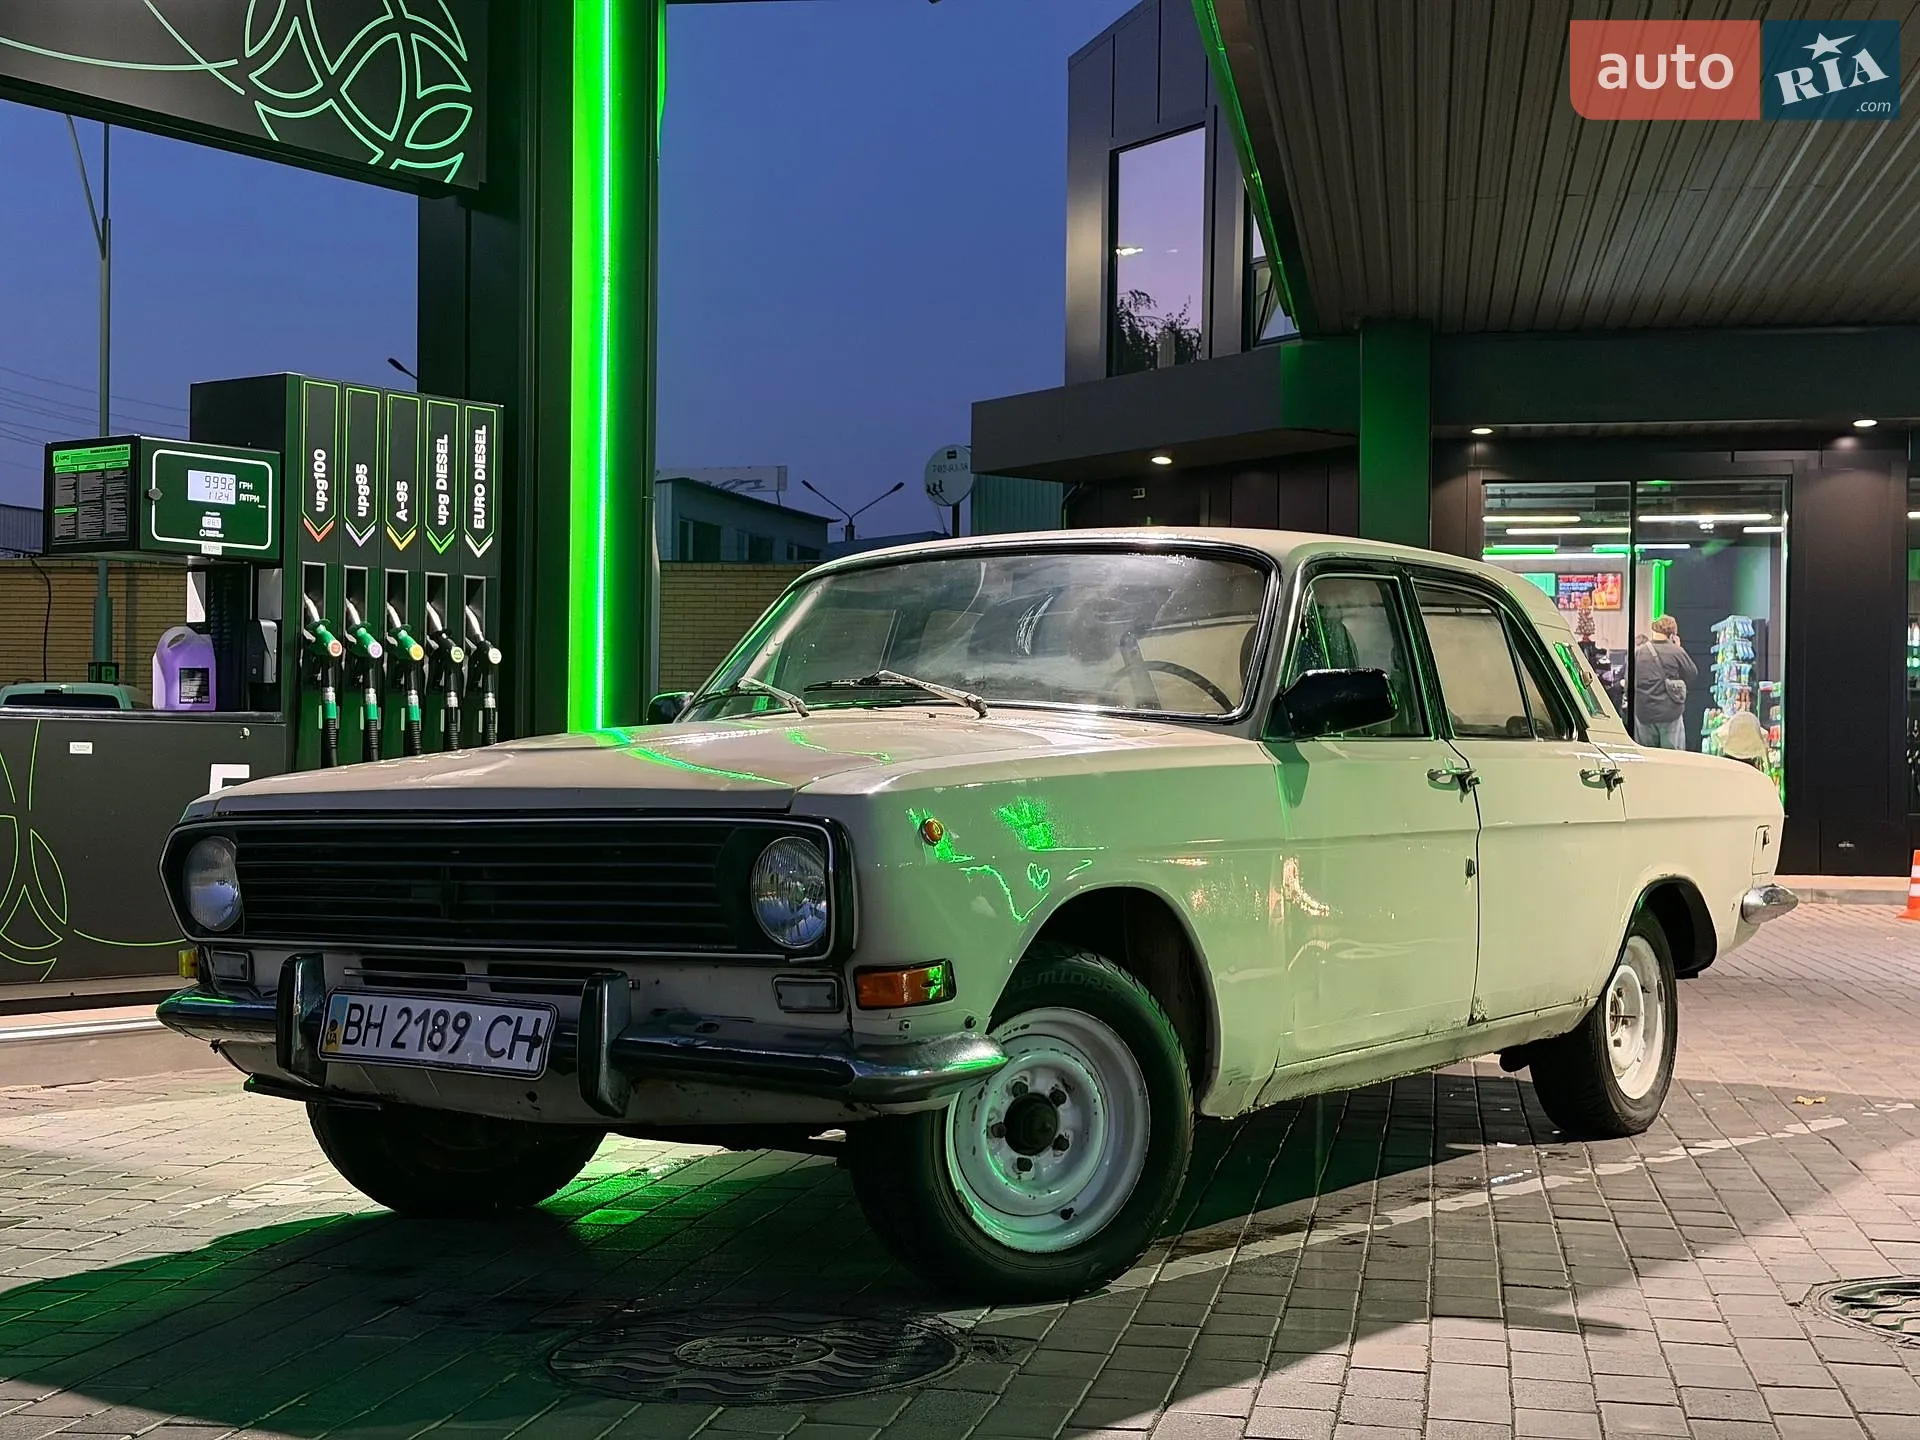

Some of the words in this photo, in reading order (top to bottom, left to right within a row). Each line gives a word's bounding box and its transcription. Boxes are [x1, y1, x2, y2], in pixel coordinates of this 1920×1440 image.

[436, 434, 448, 491] DIESEL
[474, 424, 487, 481] DIESEL
[239, 481, 253, 490] ГРН
[313, 449, 328, 512] upg100
[355, 463, 370, 517] upg95
[395, 480, 408, 522] A-95
[473, 483, 486, 529] EURO
[437, 493, 449, 526] upg
[341, 1003, 388, 1047] BH
[390, 1006, 472, 1054] 2189
[484, 1014, 542, 1063] CH
